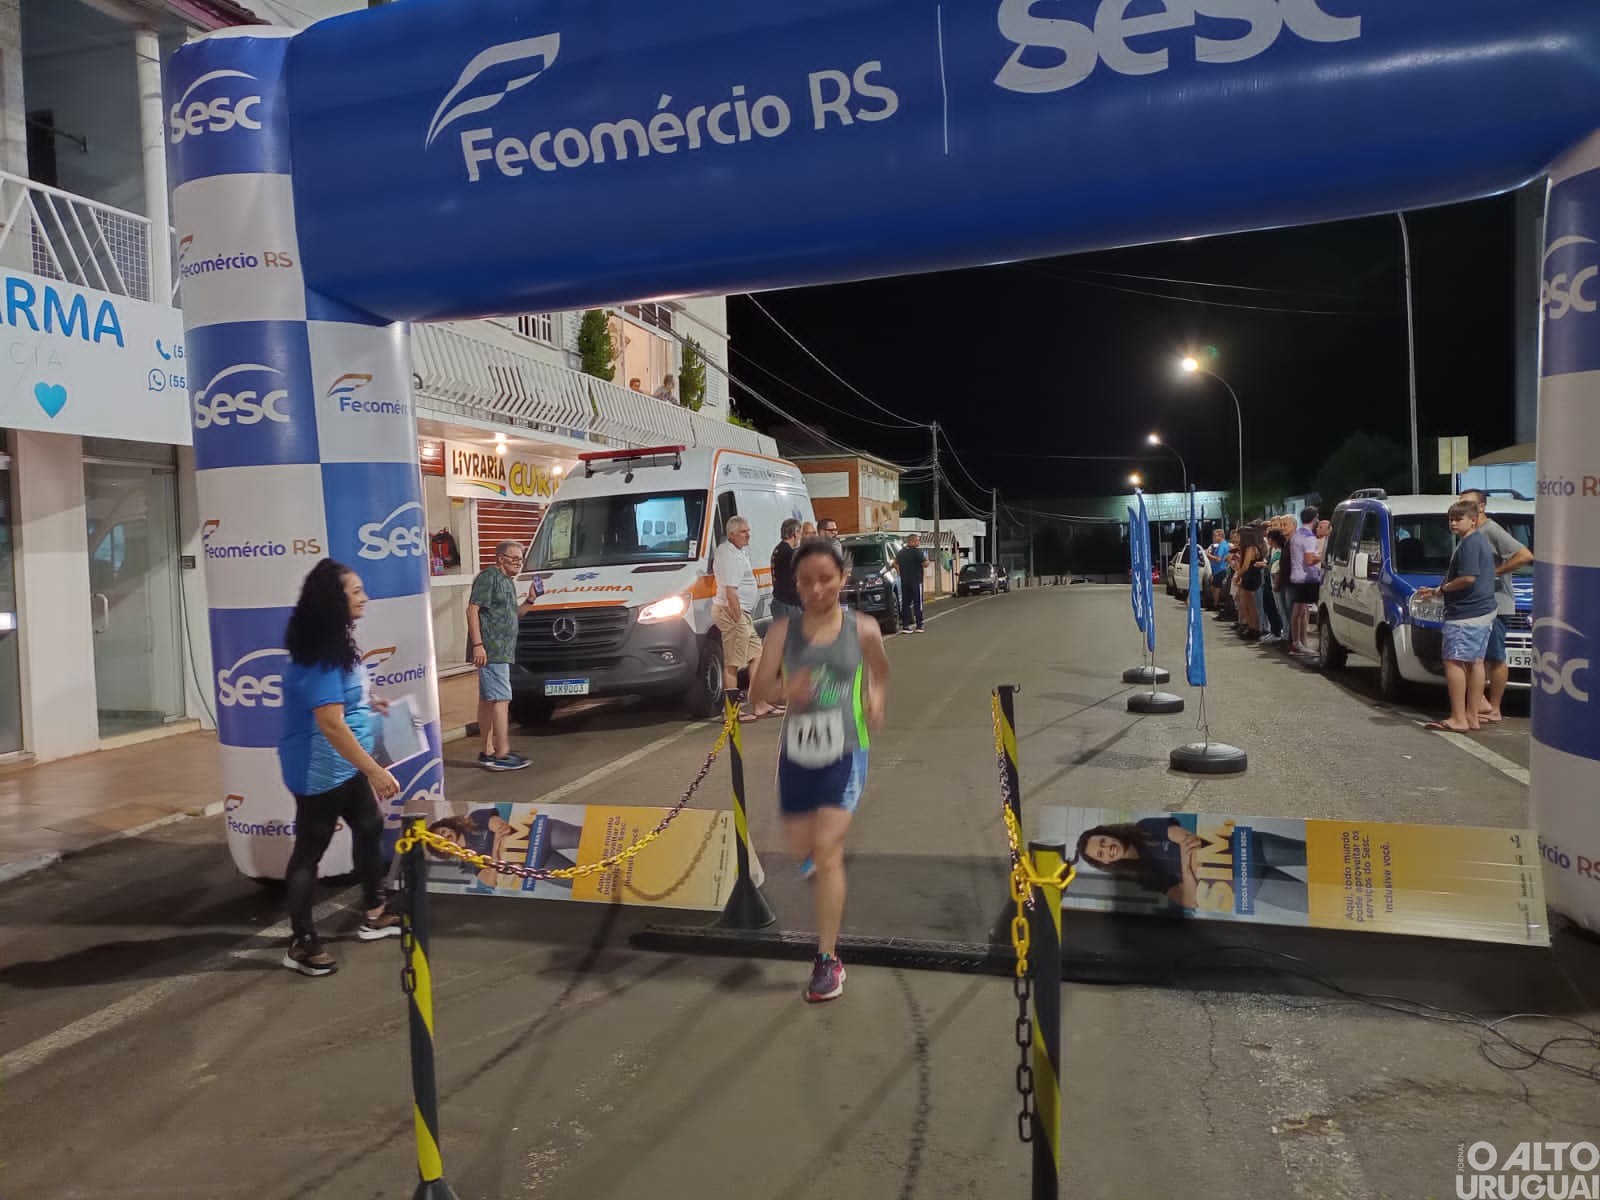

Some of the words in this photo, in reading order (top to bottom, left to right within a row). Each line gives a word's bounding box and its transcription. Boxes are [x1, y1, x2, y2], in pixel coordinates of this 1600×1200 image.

[170, 95, 262, 144] sesc
[460, 85, 792, 182] Fecomércio
[807, 60, 899, 131] RS
[263, 250, 294, 269] RS
[0, 277, 125, 348] RMA
[194, 388, 290, 429] sesc
[292, 538, 322, 556] RS
[1342, 831, 1352, 864] mundo
